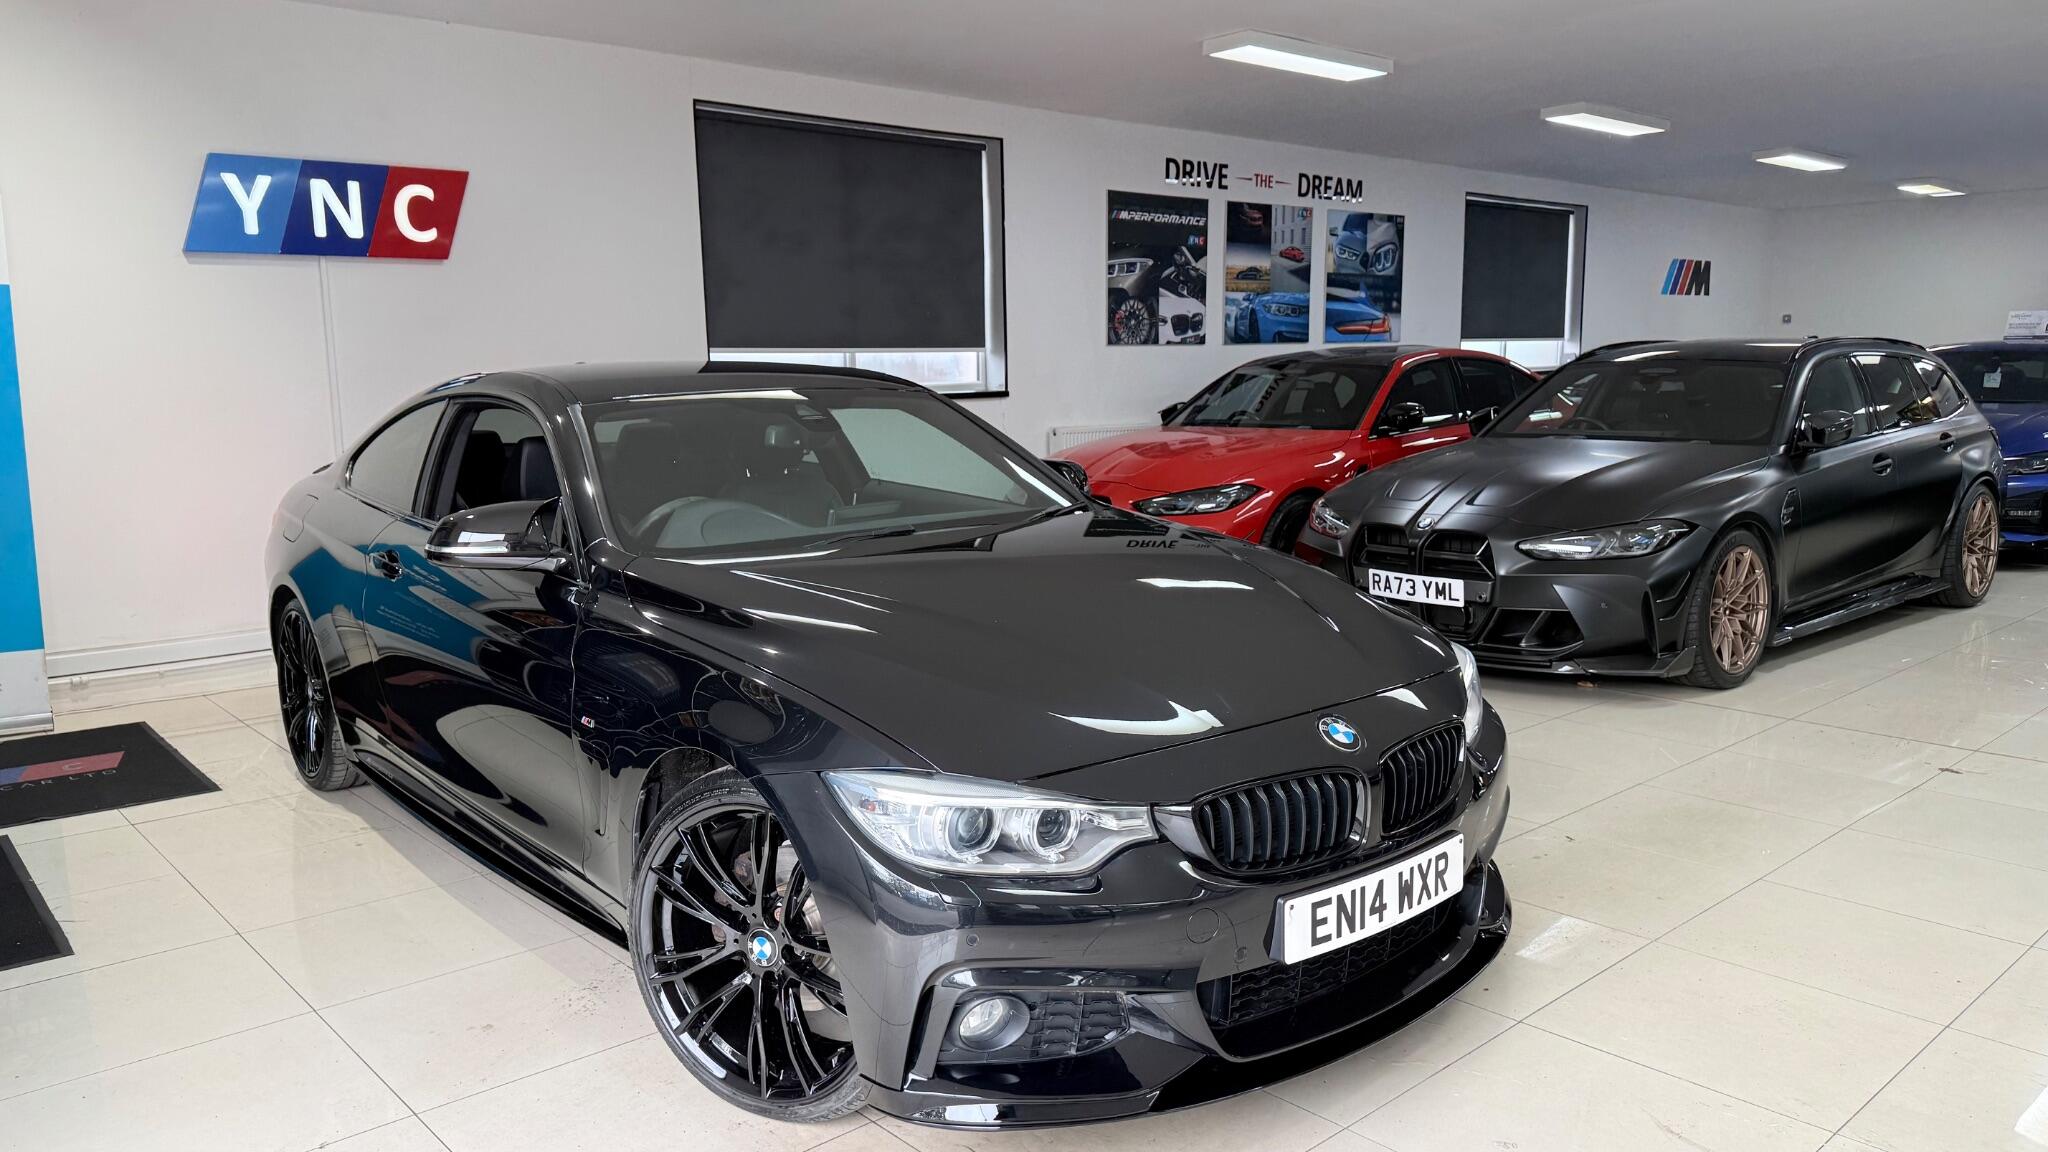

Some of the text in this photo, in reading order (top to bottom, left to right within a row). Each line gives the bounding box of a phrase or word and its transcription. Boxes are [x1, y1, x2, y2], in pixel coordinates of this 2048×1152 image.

[219, 171, 439, 243] YNC
[1165, 157, 1363, 204] DRIVE THE DREAM
[1372, 573, 1460, 602] RA73 YML
[1311, 851, 1449, 947] EN14 WXR
